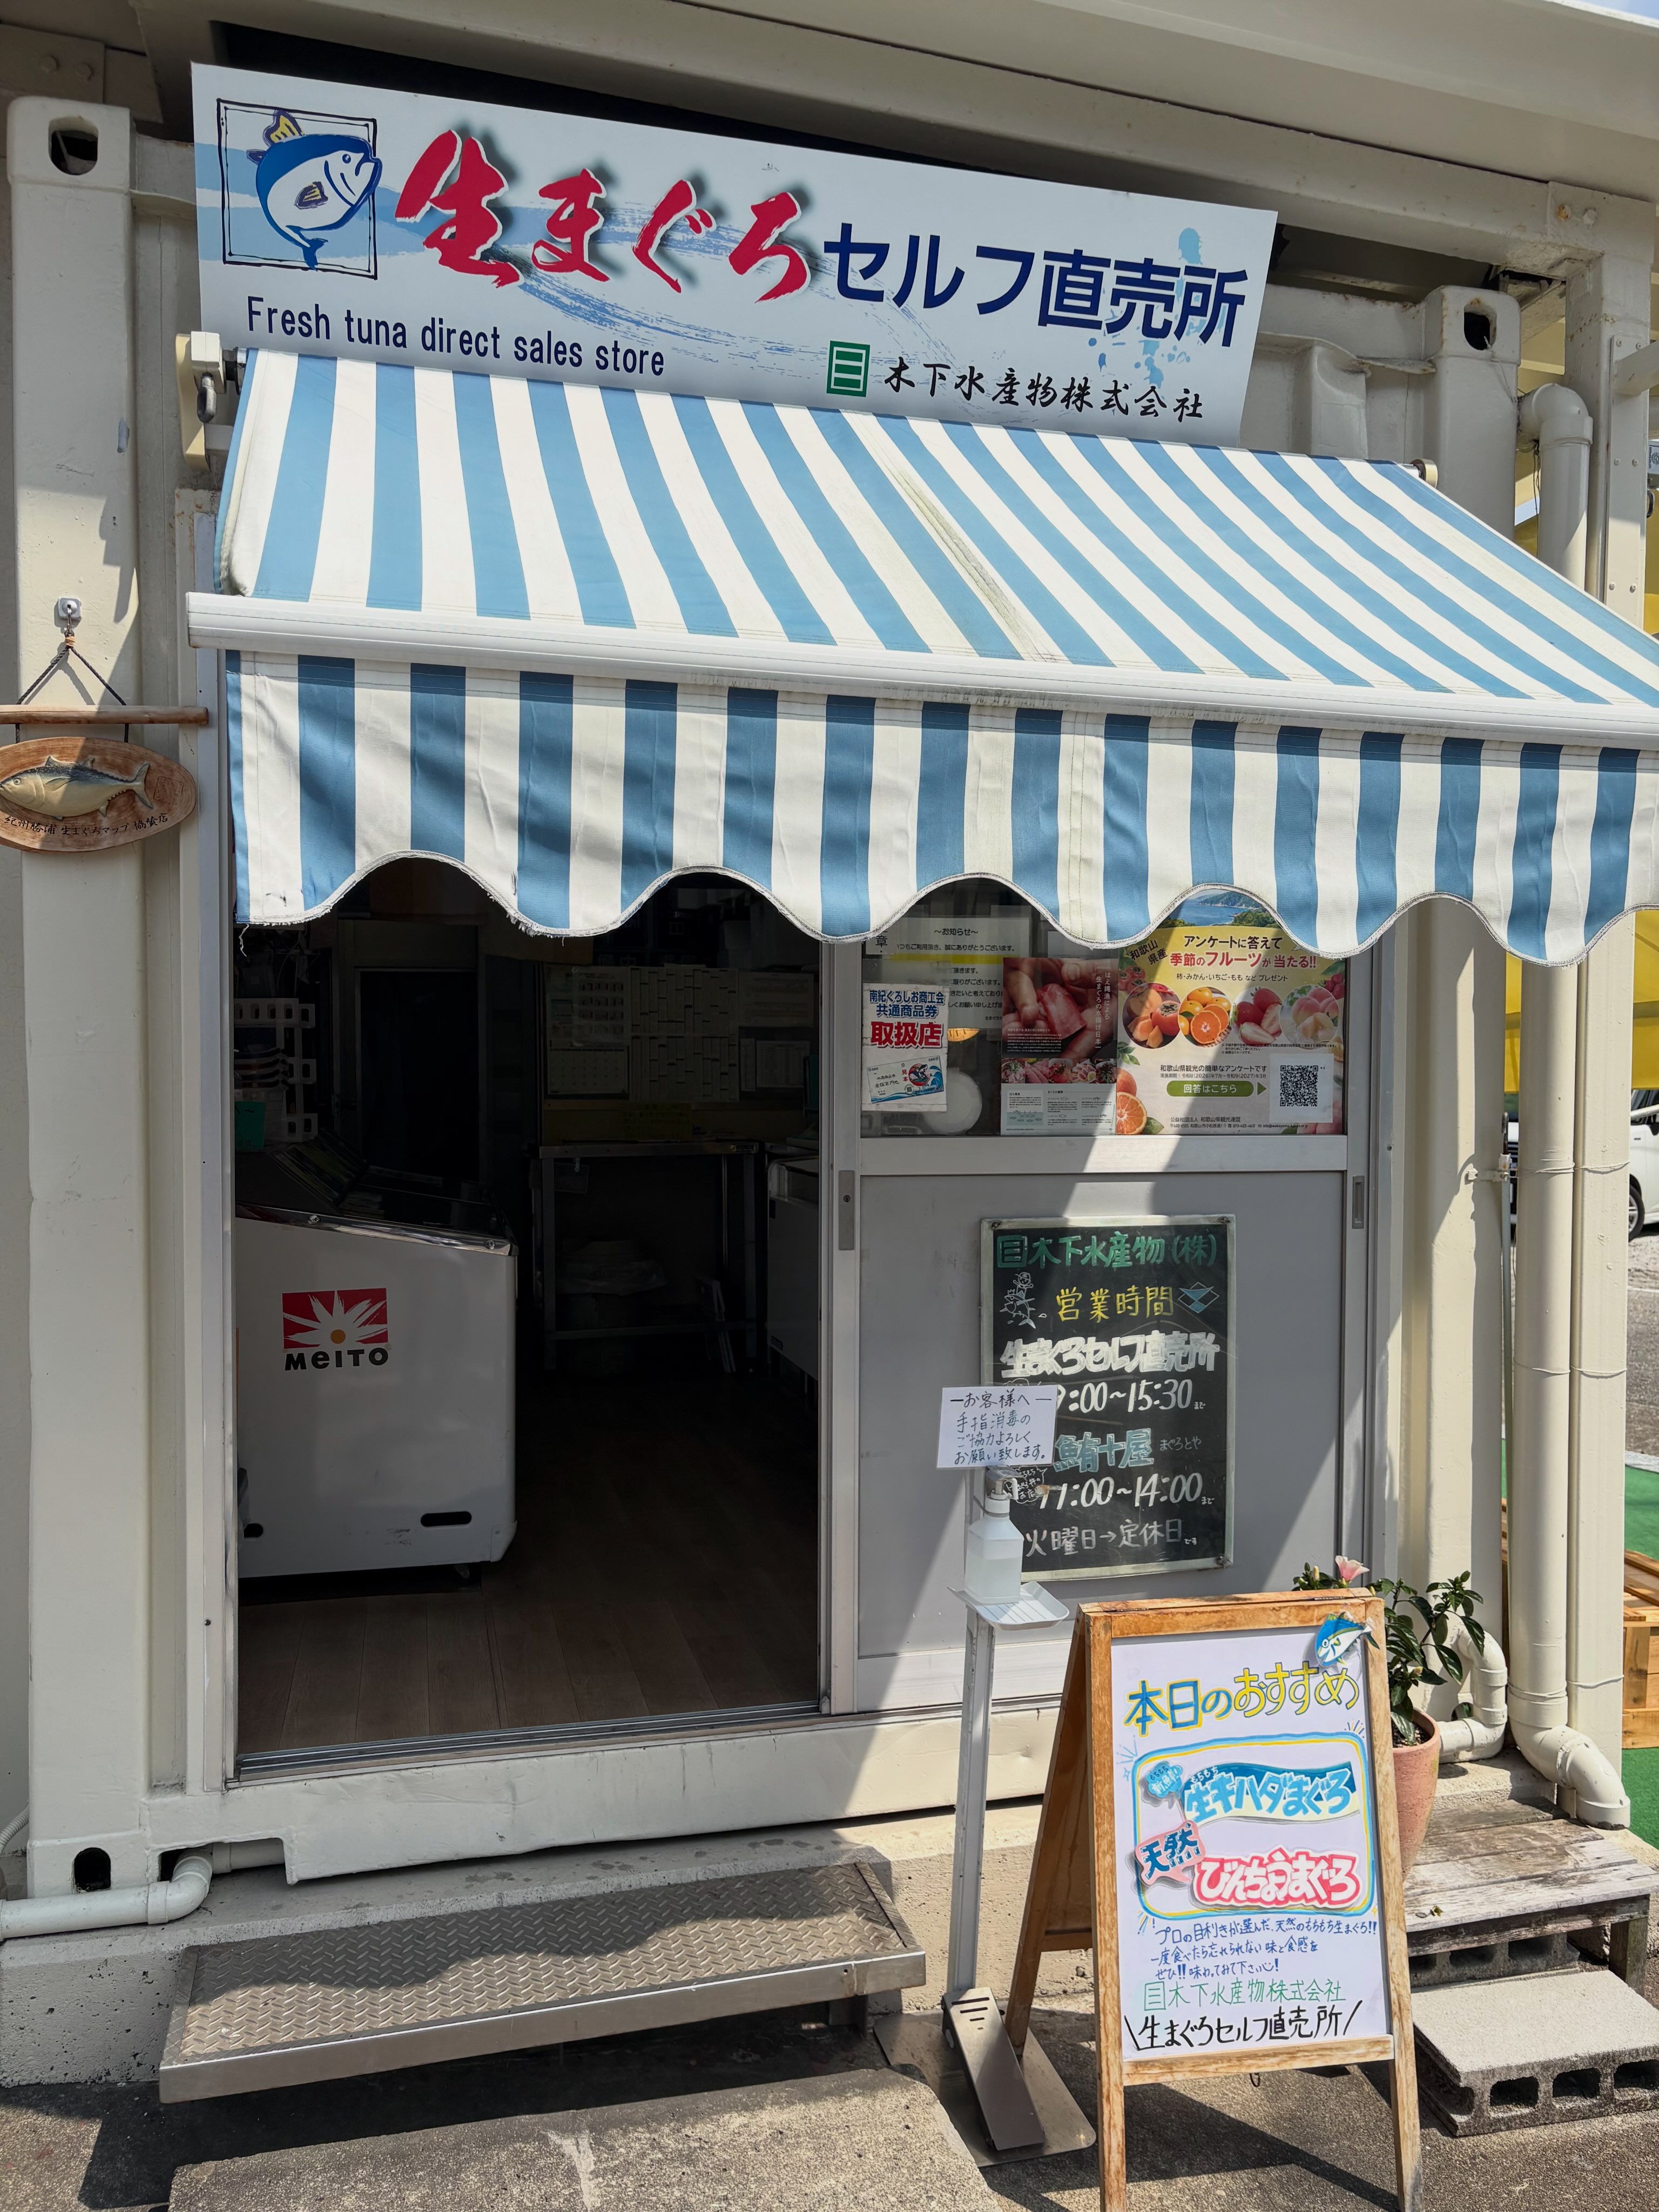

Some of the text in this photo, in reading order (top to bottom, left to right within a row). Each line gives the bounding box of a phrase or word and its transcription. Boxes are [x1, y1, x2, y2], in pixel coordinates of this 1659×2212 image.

[247, 296, 665, 376] Fresh tuna direct sales store
[884, 357, 1203, 424] 木下水産物株式会社
[1130, 940, 1158, 960] 和歌山
[1184, 935, 1283, 949] アンケートに答えて
[1149, 948, 1168, 965] 県産
[869, 990, 945, 1005] 南紀くろしお商工会
[876, 1003, 939, 1019] 共通商品券
[870, 1021, 942, 1048] 取扱店
[1183, 1084, 1237, 1094] 回答はこちら
[1056, 1285, 1174, 1323] 営業時間
[1000, 1330, 1220, 1378] 生まぐろセルフ直売所
[956, 1412, 1031, 1433] 手指消毒の
[957, 1430, 1031, 1448] ご協力よろしく
[1124, 1661, 1359, 1737] 本日のおすすめ
[1139, 1822, 1201, 1881] 天然
